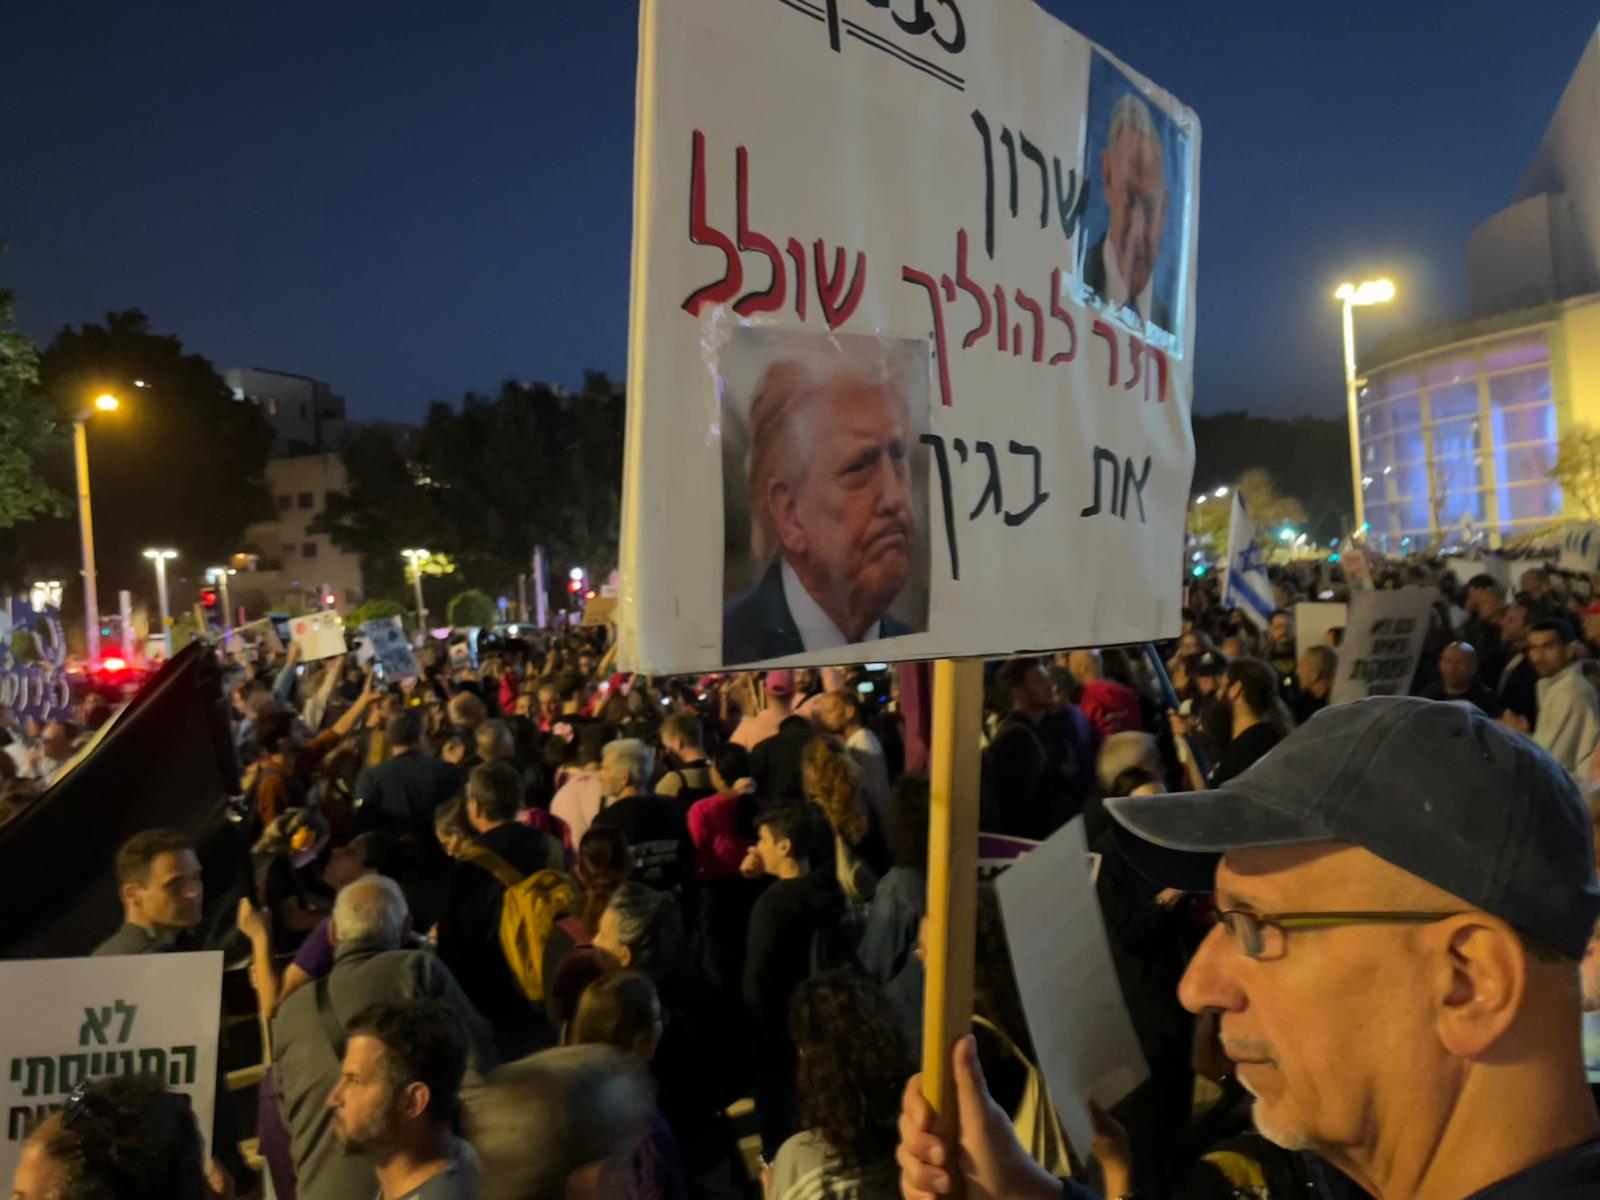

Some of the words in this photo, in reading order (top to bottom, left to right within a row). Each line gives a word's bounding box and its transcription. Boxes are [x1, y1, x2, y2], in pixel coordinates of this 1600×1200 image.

[680, 128, 867, 331] שולל
[970, 108, 1090, 260] שרון
[902, 227, 1078, 407] להוליך
[919, 434, 1050, 581] בגין
[1080, 445, 1152, 524] את
[79, 998, 138, 1046] לא
